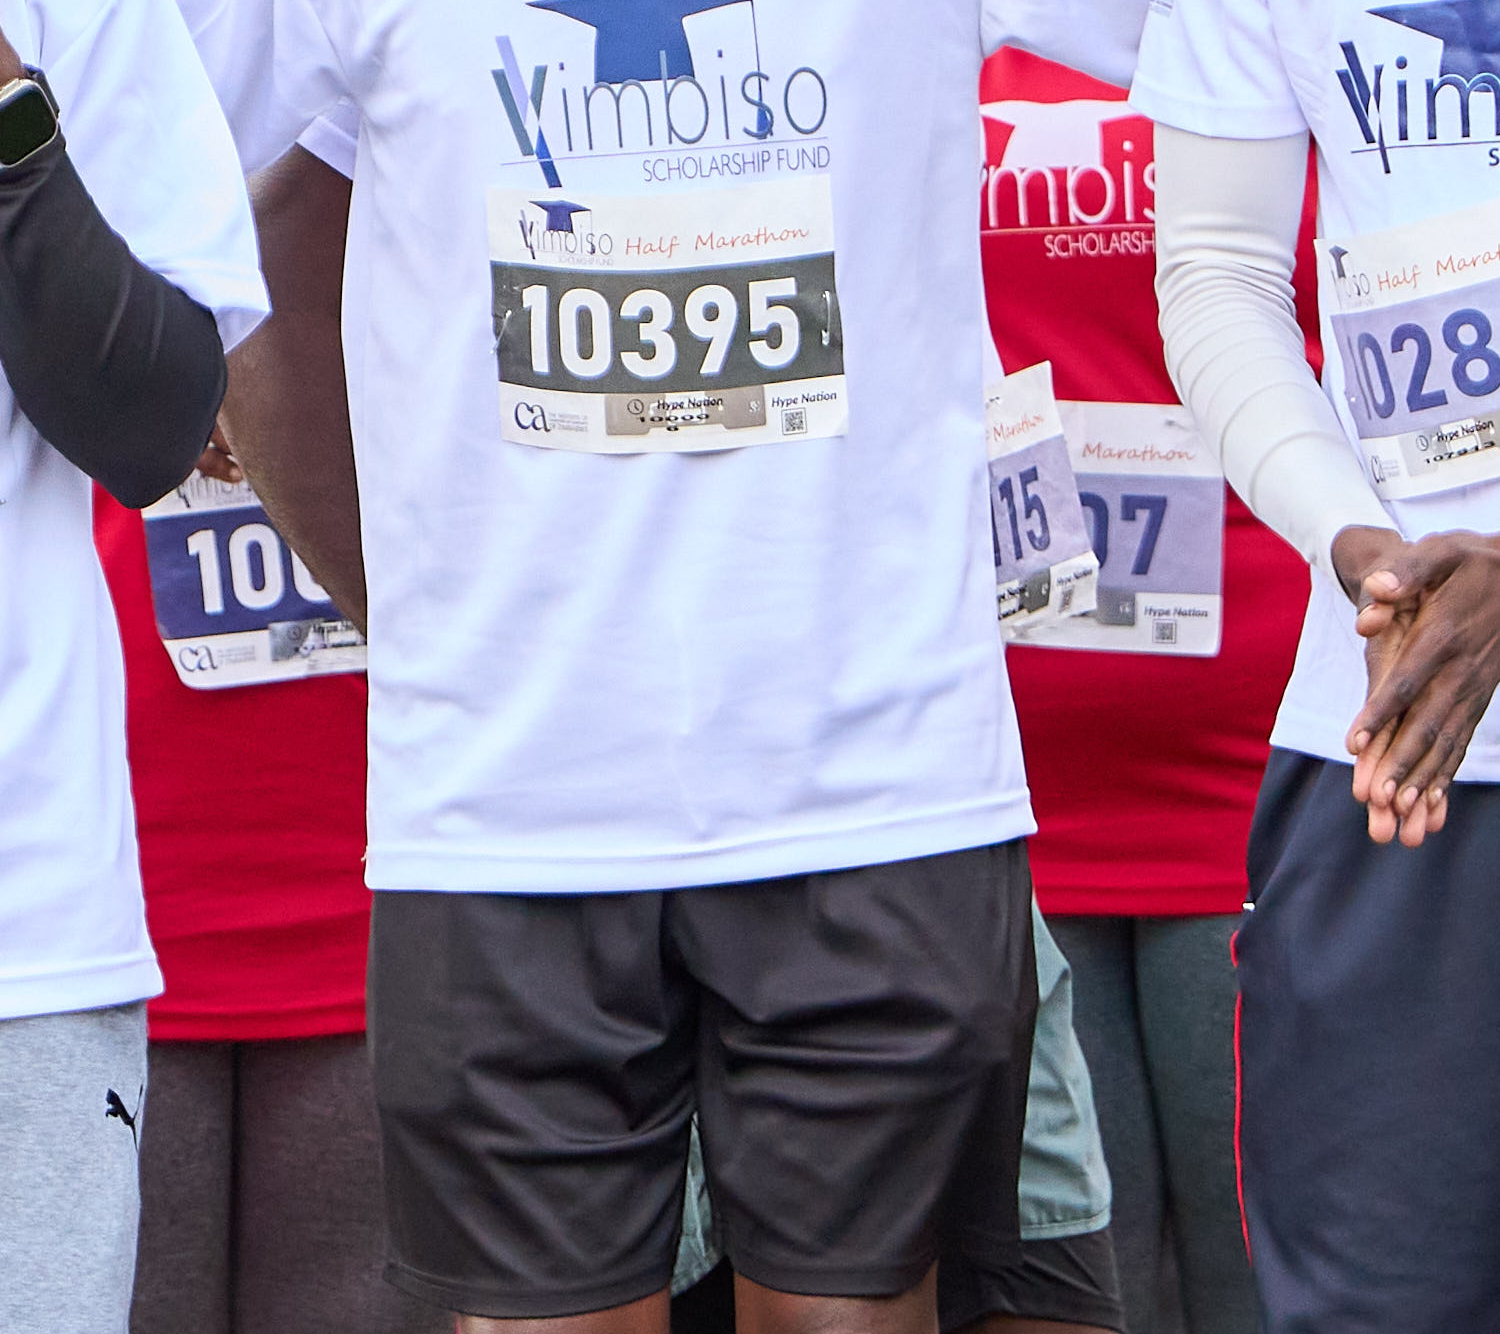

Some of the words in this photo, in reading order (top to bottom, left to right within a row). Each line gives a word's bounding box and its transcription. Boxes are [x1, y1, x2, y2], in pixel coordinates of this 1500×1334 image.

[643, 151, 771, 181] SCHOLARSHIP
[776, 146, 830, 171] FUND
[625, 236, 680, 256] Half
[695, 225, 811, 251] Marathon
[1377, 264, 1422, 291] Half
[520, 277, 800, 379] 10395
[657, 398, 685, 410] Hype
[688, 396, 724, 408] Nation
[771, 396, 799, 409] Hype
[801, 391, 837, 404] Nation
[514, 401, 551, 433] ca
[1082, 442, 1196, 461] Marathon
[1144, 605, 1173, 618] Hype
[1174, 606, 1209, 618] Nation
